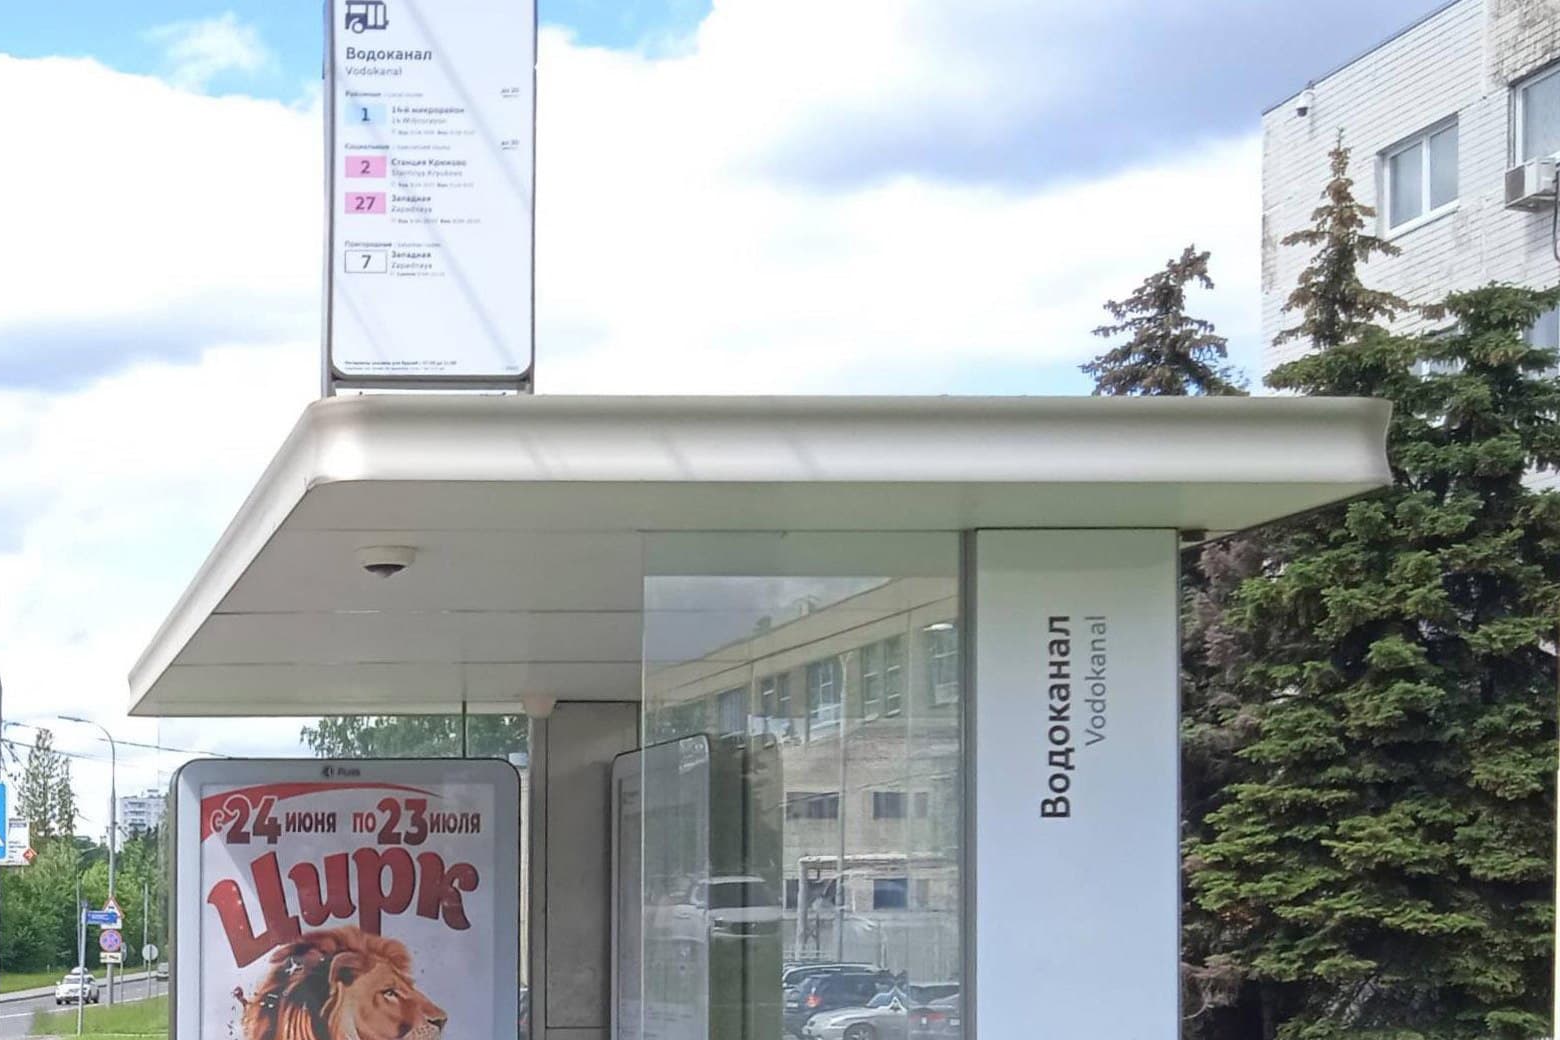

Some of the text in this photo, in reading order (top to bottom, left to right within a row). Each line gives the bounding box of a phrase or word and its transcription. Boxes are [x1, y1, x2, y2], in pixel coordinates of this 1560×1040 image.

[345, 46, 432, 62] Водоканал
[345, 66, 402, 76] Vodokanal
[361, 107, 371, 122] 1
[360, 159, 371, 175] 2
[355, 196, 376, 211] 27
[361, 254, 372, 270] 7
[1085, 616, 1107, 746] Vodokanal
[1040, 616, 1075, 818] Водоканал
[222, 794, 282, 844] 24
[285, 812, 337, 833] ИЮНЯ
[352, 812, 377, 833] ПО
[376, 797, 429, 846] 23
[429, 812, 481, 834] ИЮЛЯ
[207, 847, 481, 968] Цирк
